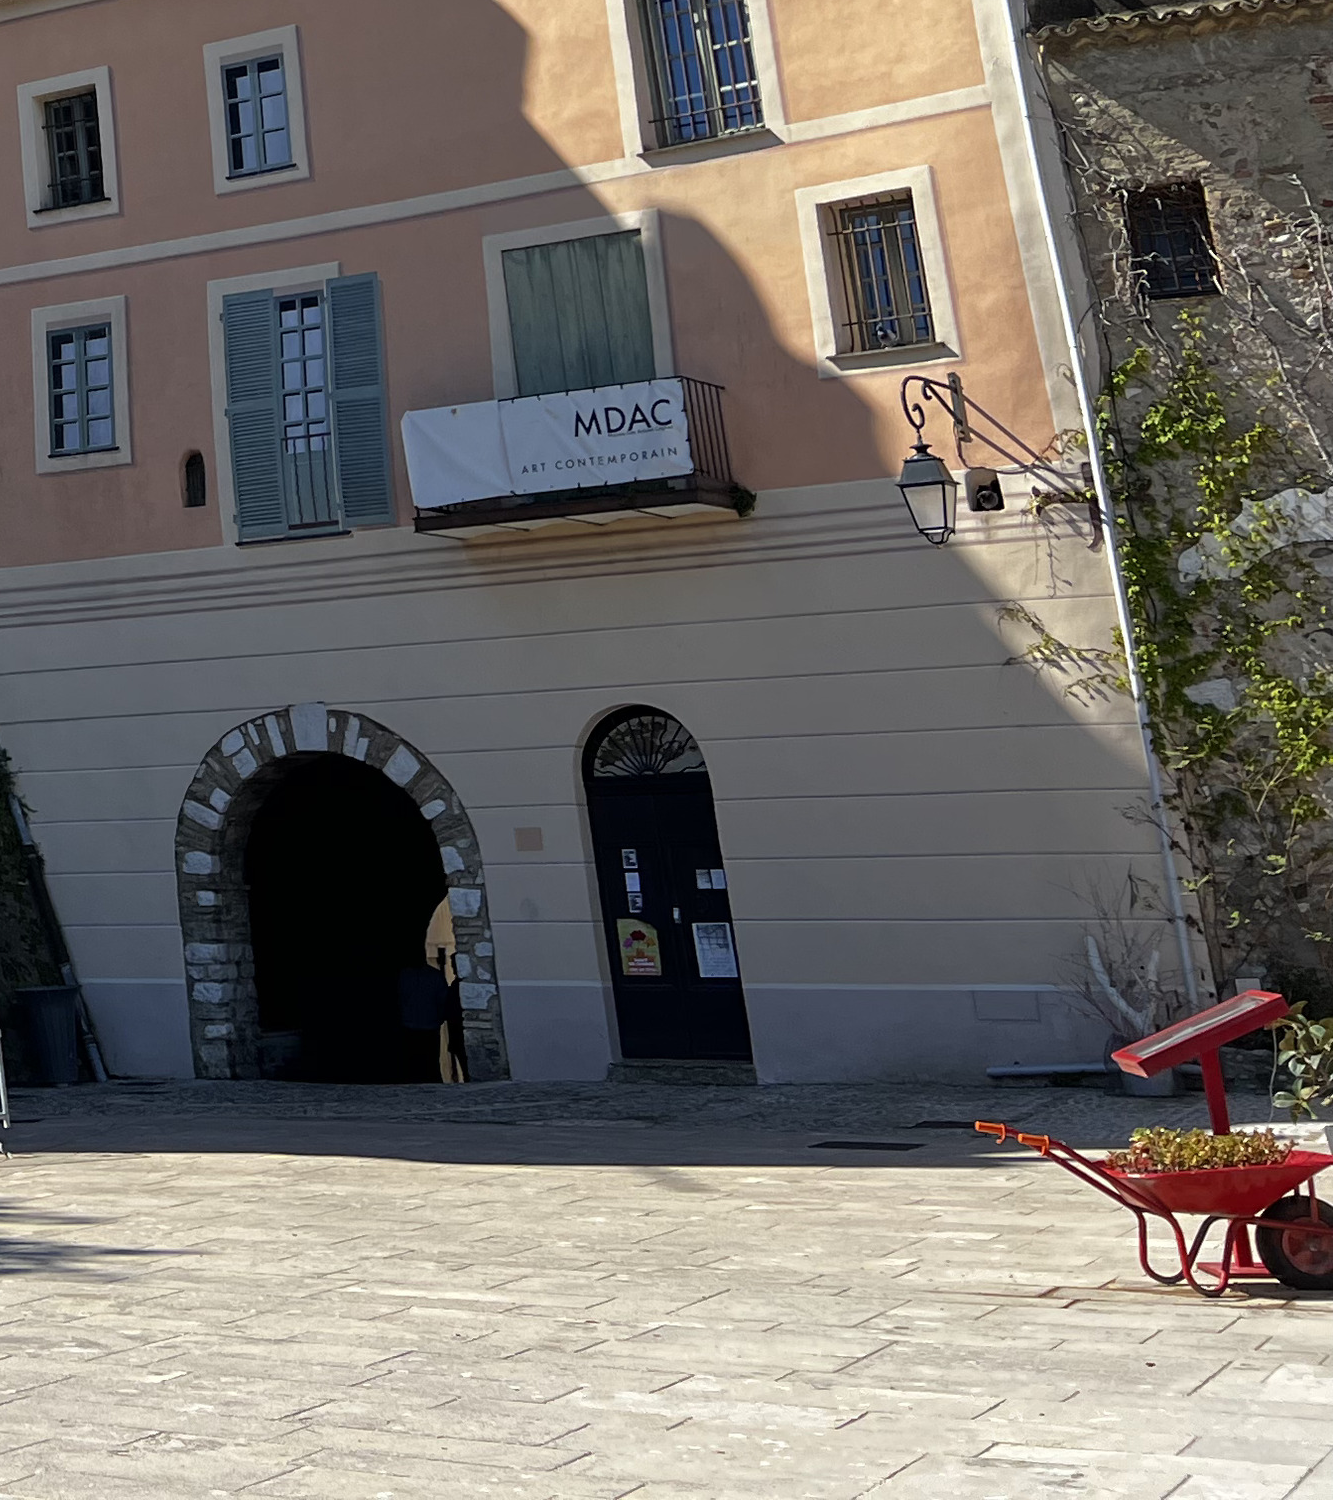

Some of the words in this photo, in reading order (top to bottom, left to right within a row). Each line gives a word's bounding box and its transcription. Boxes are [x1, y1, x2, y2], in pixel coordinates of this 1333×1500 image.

[574, 399, 672, 437] MDAC
[521, 462, 546, 474] ART
[554, 447, 678, 470] CONTEMPORAIN
